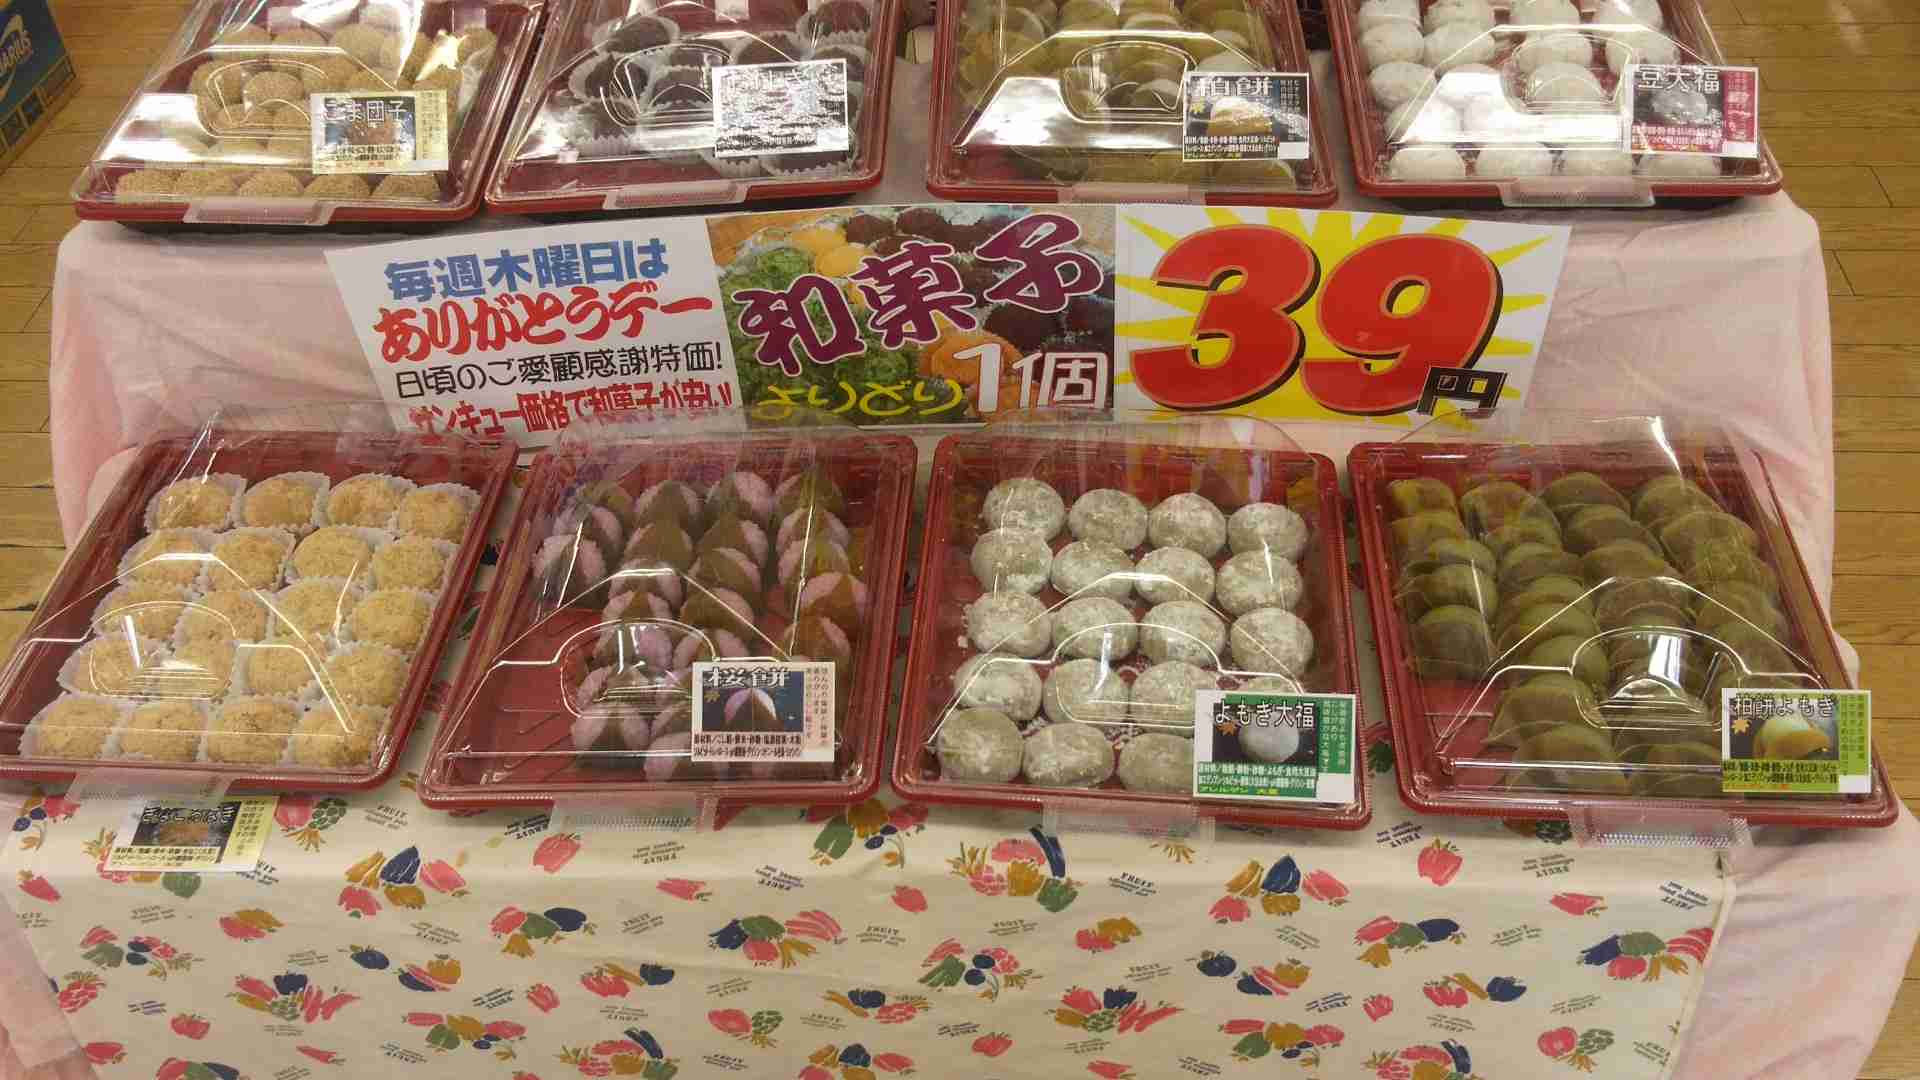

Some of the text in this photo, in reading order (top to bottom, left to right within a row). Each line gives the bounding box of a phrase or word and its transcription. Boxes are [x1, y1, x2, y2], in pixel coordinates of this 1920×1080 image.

[1638, 65, 1720, 93] 豆大福
[383, 238, 670, 302] 毎週木曜日は
[732, 212, 1104, 378] 和菓子
[374, 280, 713, 364] ありがとうデー
[396, 341, 722, 399] 日頃のご愛顧感謝特価!
[953, 343, 1108, 414] 1個
[708, 666, 790, 688] 桜餅
[1215, 699, 1316, 729] よもぎ大福
